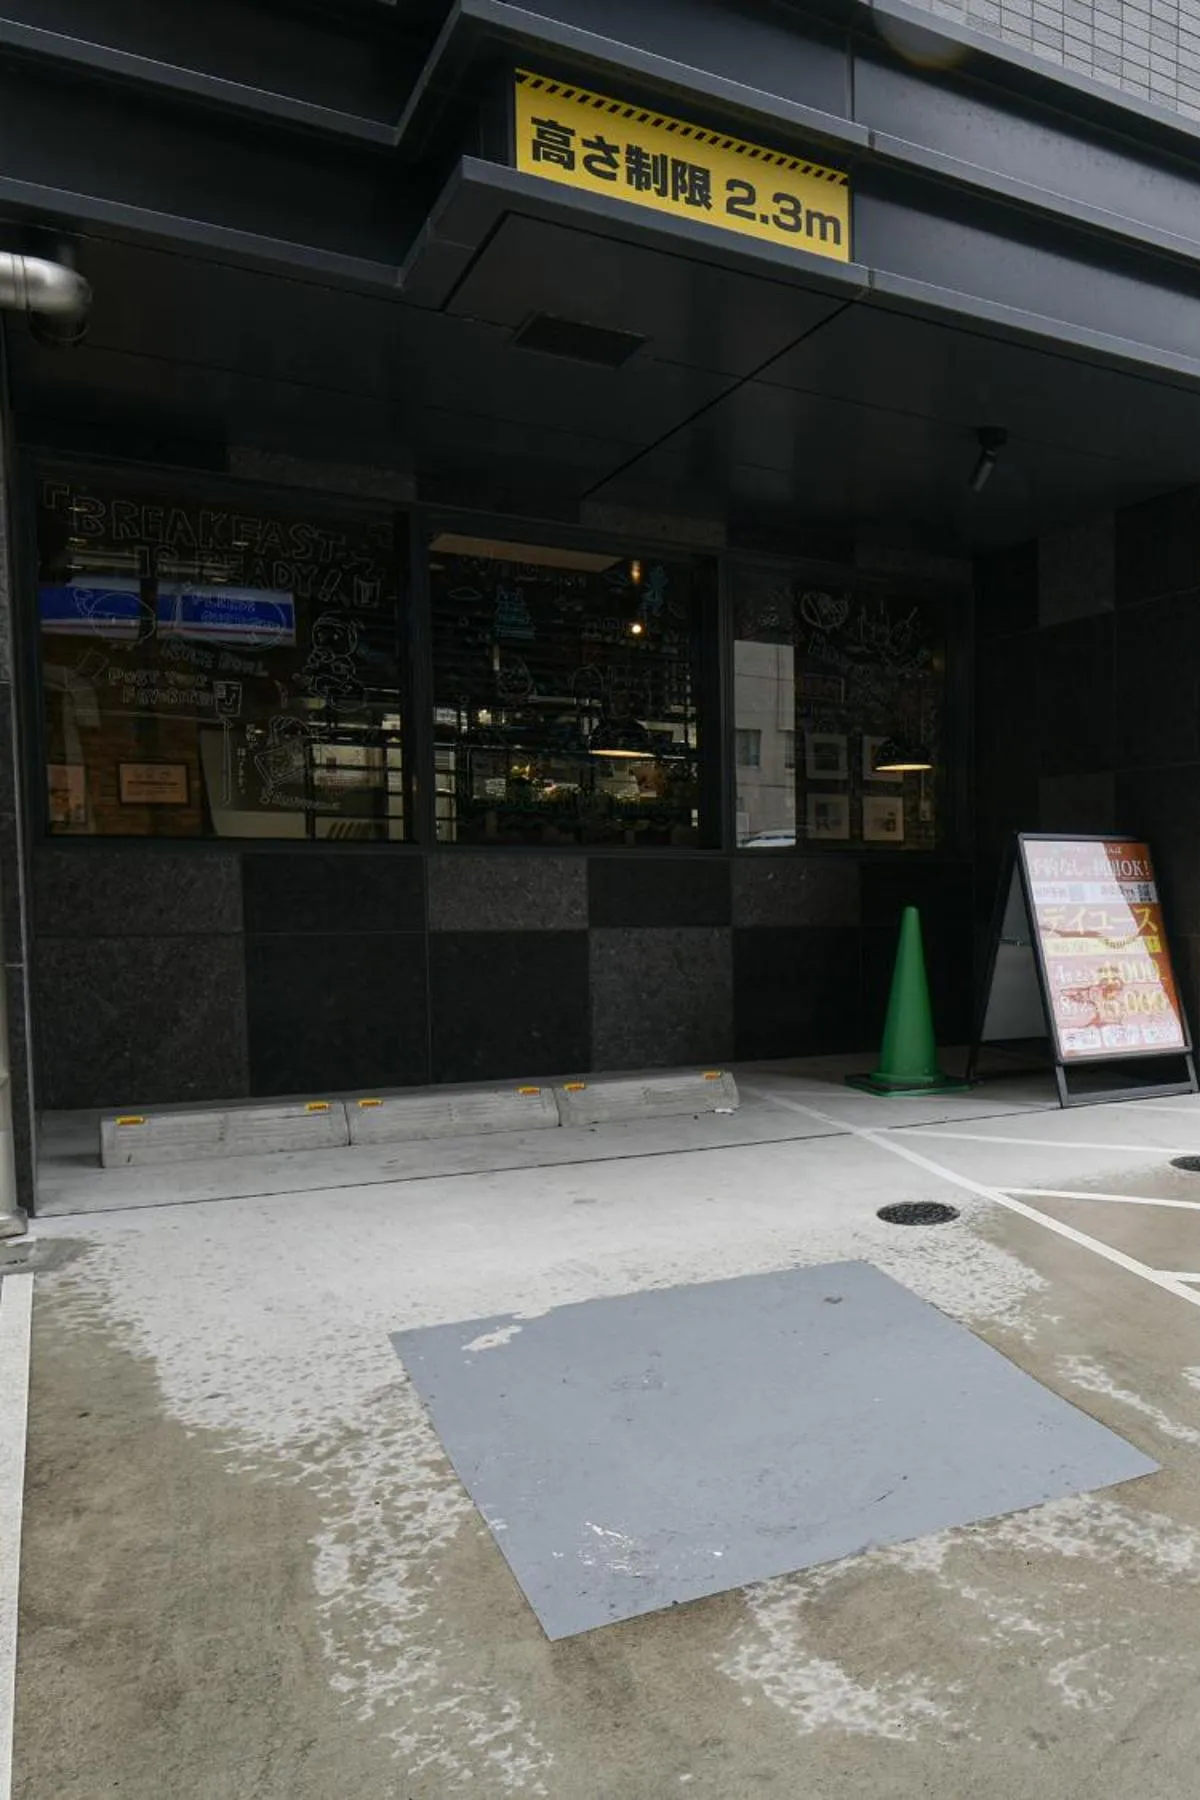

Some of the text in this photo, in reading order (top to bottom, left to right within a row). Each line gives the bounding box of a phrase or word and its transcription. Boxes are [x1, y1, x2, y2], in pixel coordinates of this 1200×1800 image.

[530, 116, 841, 245] 高さ制限 2.3m
